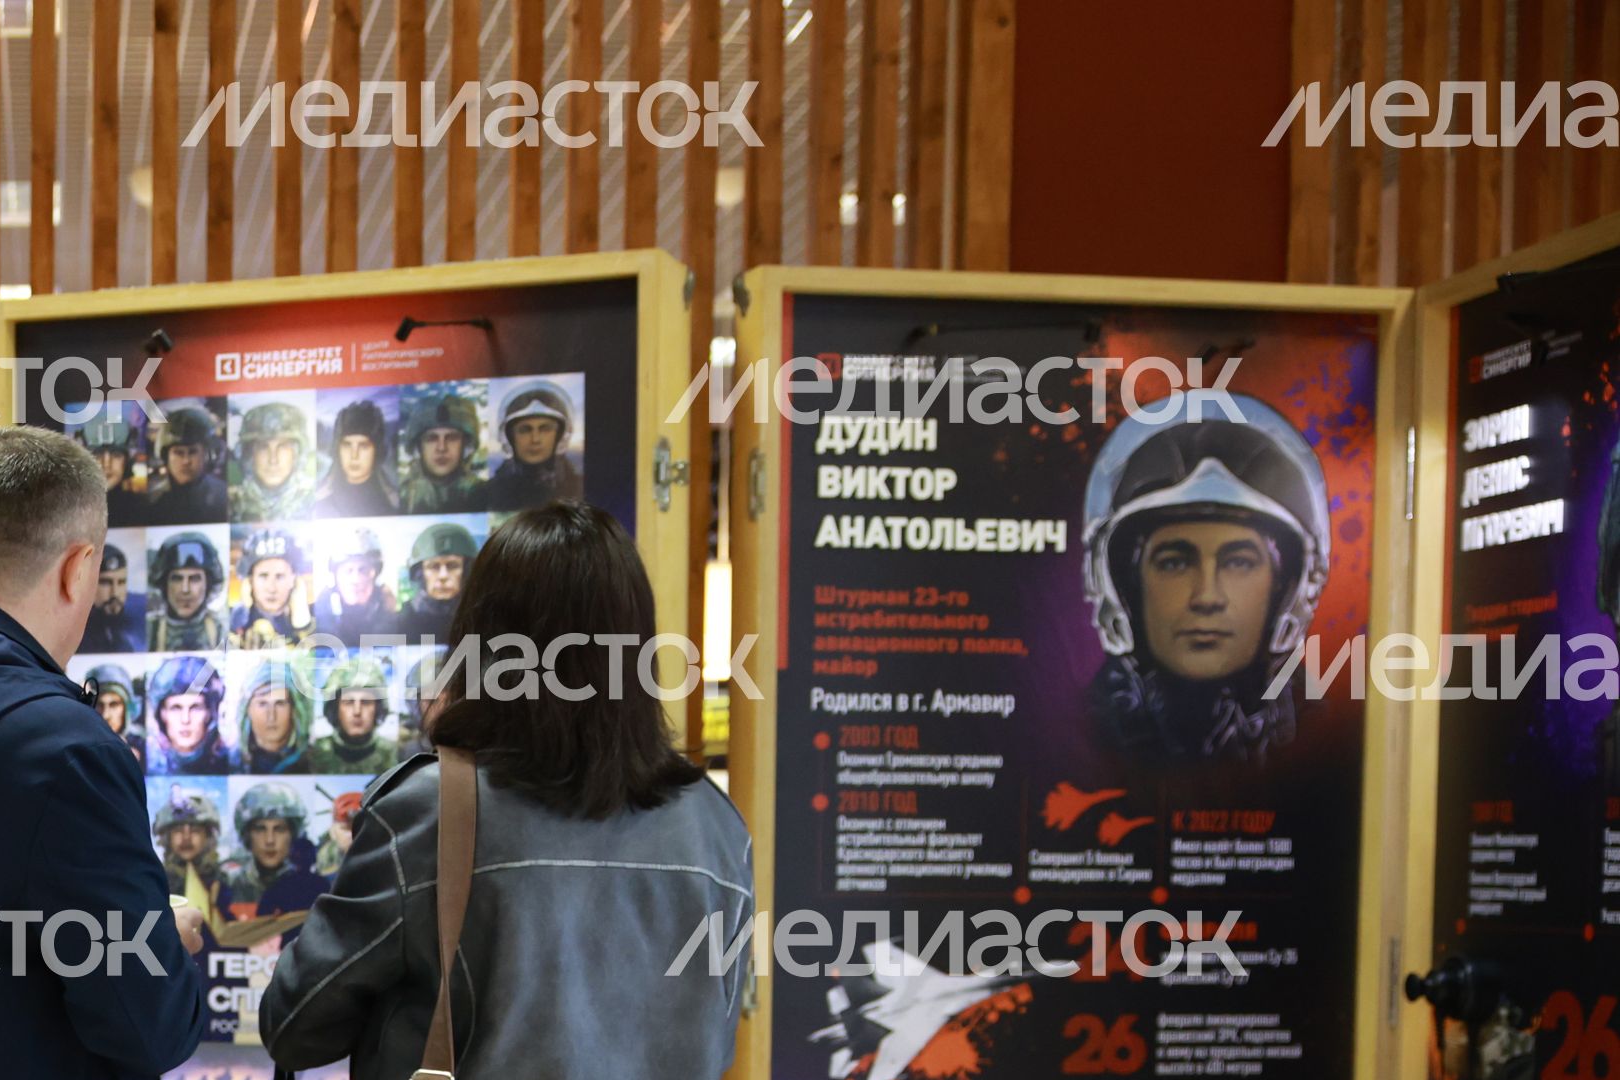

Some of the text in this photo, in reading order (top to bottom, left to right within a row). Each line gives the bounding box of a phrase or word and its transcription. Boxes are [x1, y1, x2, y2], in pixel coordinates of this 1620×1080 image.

[244, 346, 343, 363] УНИВЕРСИТЕТ
[243, 357, 343, 379] СИНЕРГИЯ
[815, 416, 938, 455] ДУДИН
[1464, 404, 1530, 452] ЗОРИН
[817, 465, 958, 500] ВИКТОР
[1461, 454, 1530, 508] ДЕНИС
[814, 514, 1067, 552] АНАТОЛЬЕВИЧ
[814, 585, 969, 609] Штурман 23-го
[814, 610, 989, 631] истребительного
[814, 636, 958, 655] авиационного
[814, 658, 878, 678] майор
[810, 687, 1016, 719] Родился в г. Армавир
[883, 725, 919, 749] ГОД
[882, 790, 917, 814] ГОД
[1061, 1013, 1148, 1075] 26
